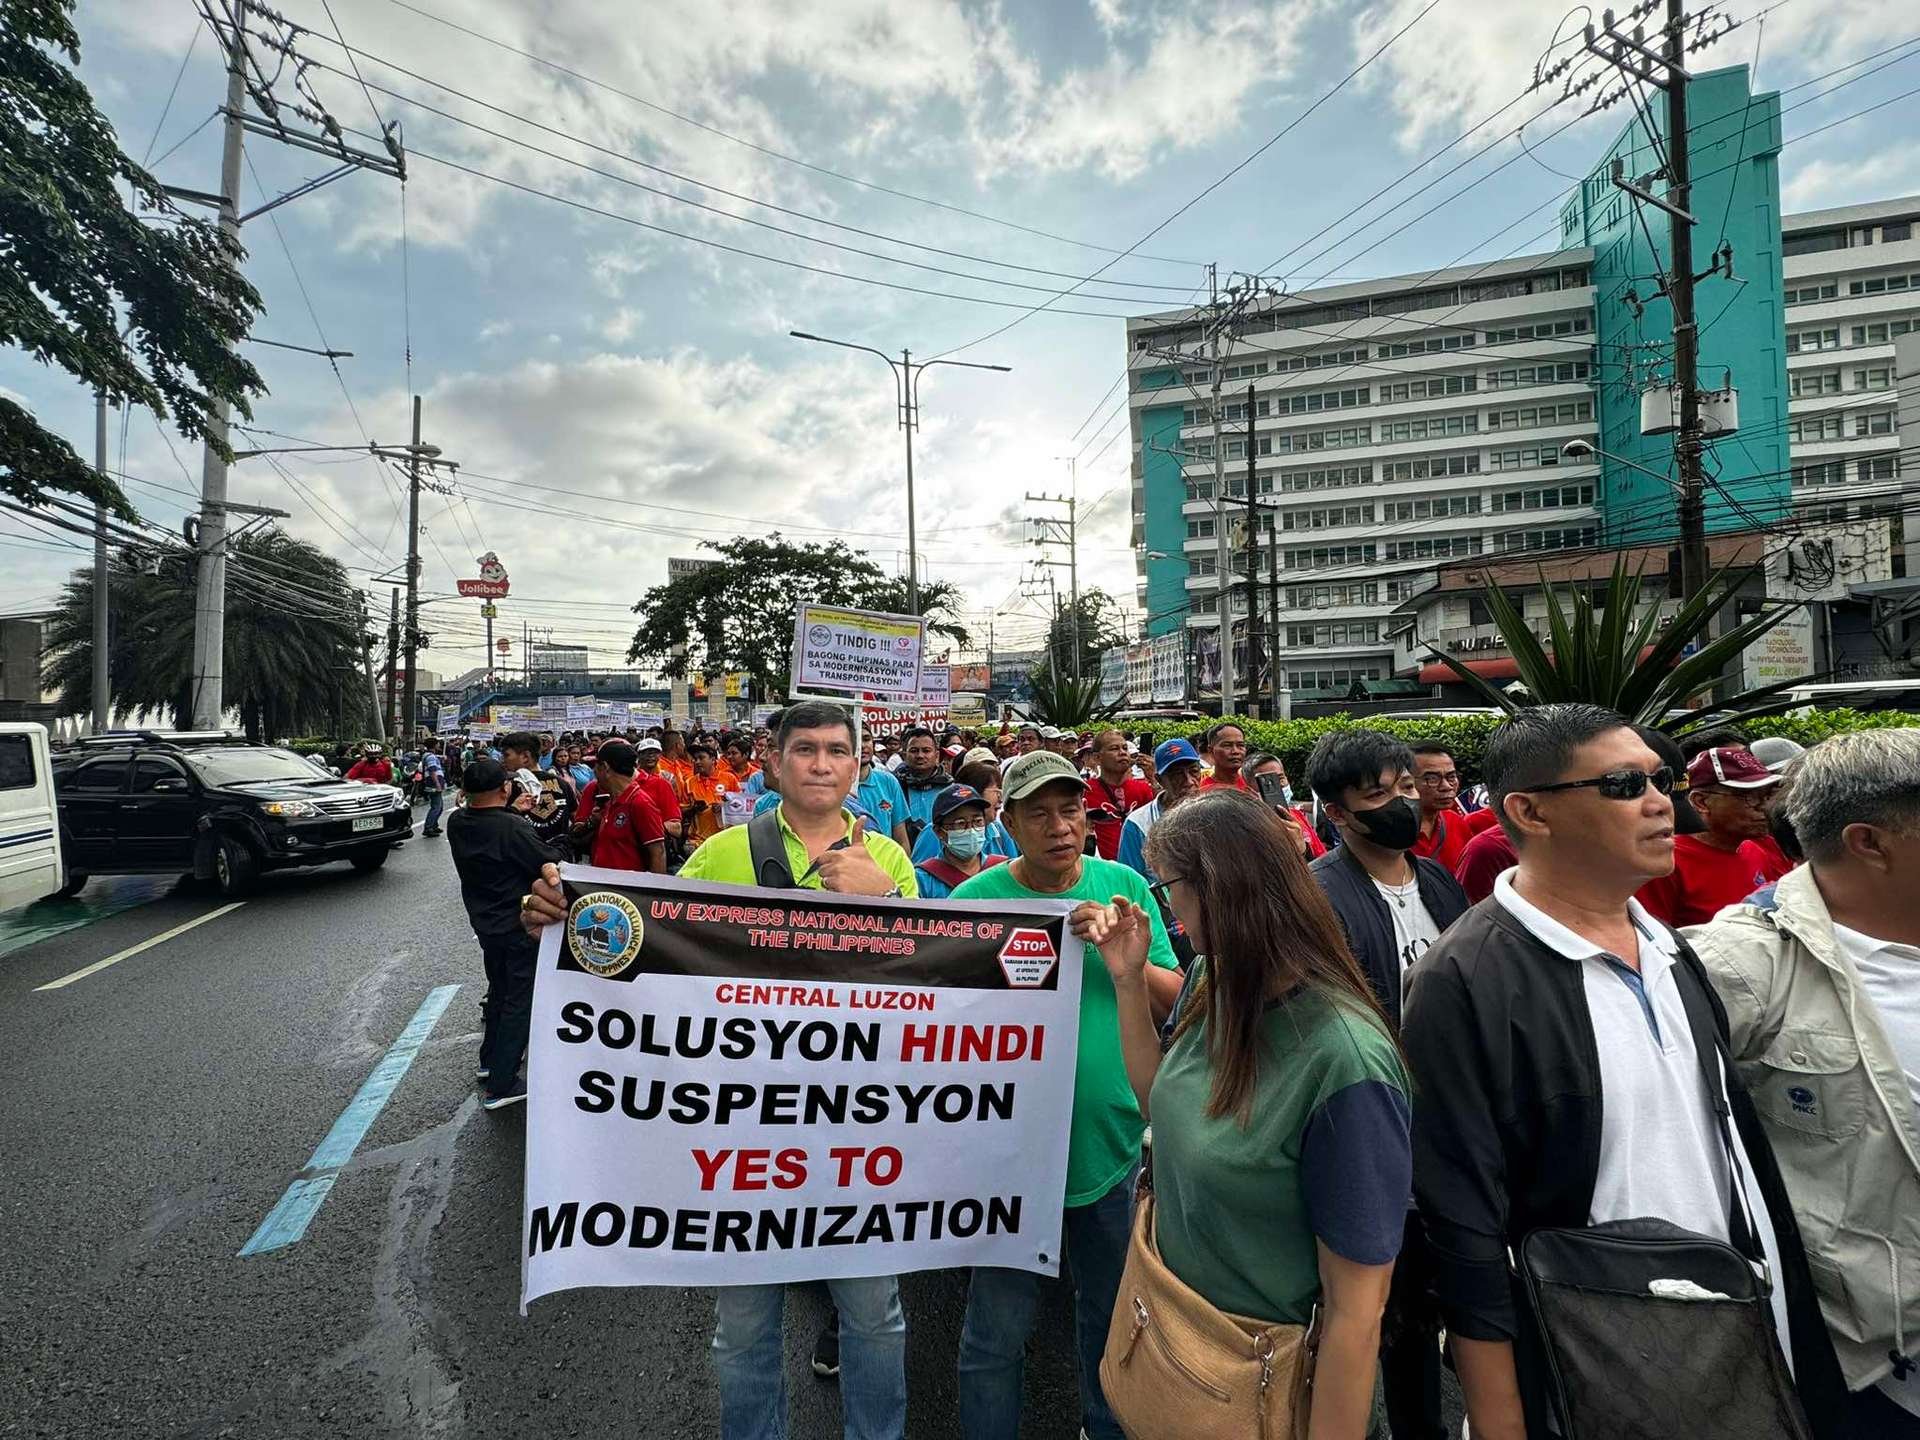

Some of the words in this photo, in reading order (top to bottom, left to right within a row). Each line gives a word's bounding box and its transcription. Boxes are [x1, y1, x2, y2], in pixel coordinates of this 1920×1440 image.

[460, 583, 505, 594] Jollibee
[835, 634, 877, 649] TINDIG
[807, 651, 845, 661] BAGONG
[848, 654, 890, 667] PILIPINAS
[893, 660, 914, 668] PARA
[809, 660, 820, 668] SA
[823, 661, 898, 677] MODERNISASYON
[900, 669, 913, 677] NG
[819, 671, 903, 686] TRANSPORTASYON!
[861, 709, 925, 722] SOLUSYON
[650, 901, 683, 919] UV
[686, 903, 784, 926] EXPRESS
[789, 911, 889, 933] NATIONAL
[891, 917, 973, 938] ALLIACE
[977, 922, 1004, 939] OF
[748, 929, 789, 948] THE
[794, 932, 915, 955] PHILIPPINES
[1013, 939, 1047, 951] STOP
[715, 984, 840, 1008] CENTRAL
[850, 989, 936, 1011] LUZON
[556, 1001, 881, 1062] SOLUSYON
[900, 1024, 1045, 1062] HINDI
[574, 1070, 1015, 1125] SUSPENSYON
[691, 1148, 808, 1191] YES
[829, 1146, 903, 1187] TO
[528, 1196, 1022, 1258] MODERNIZATION
